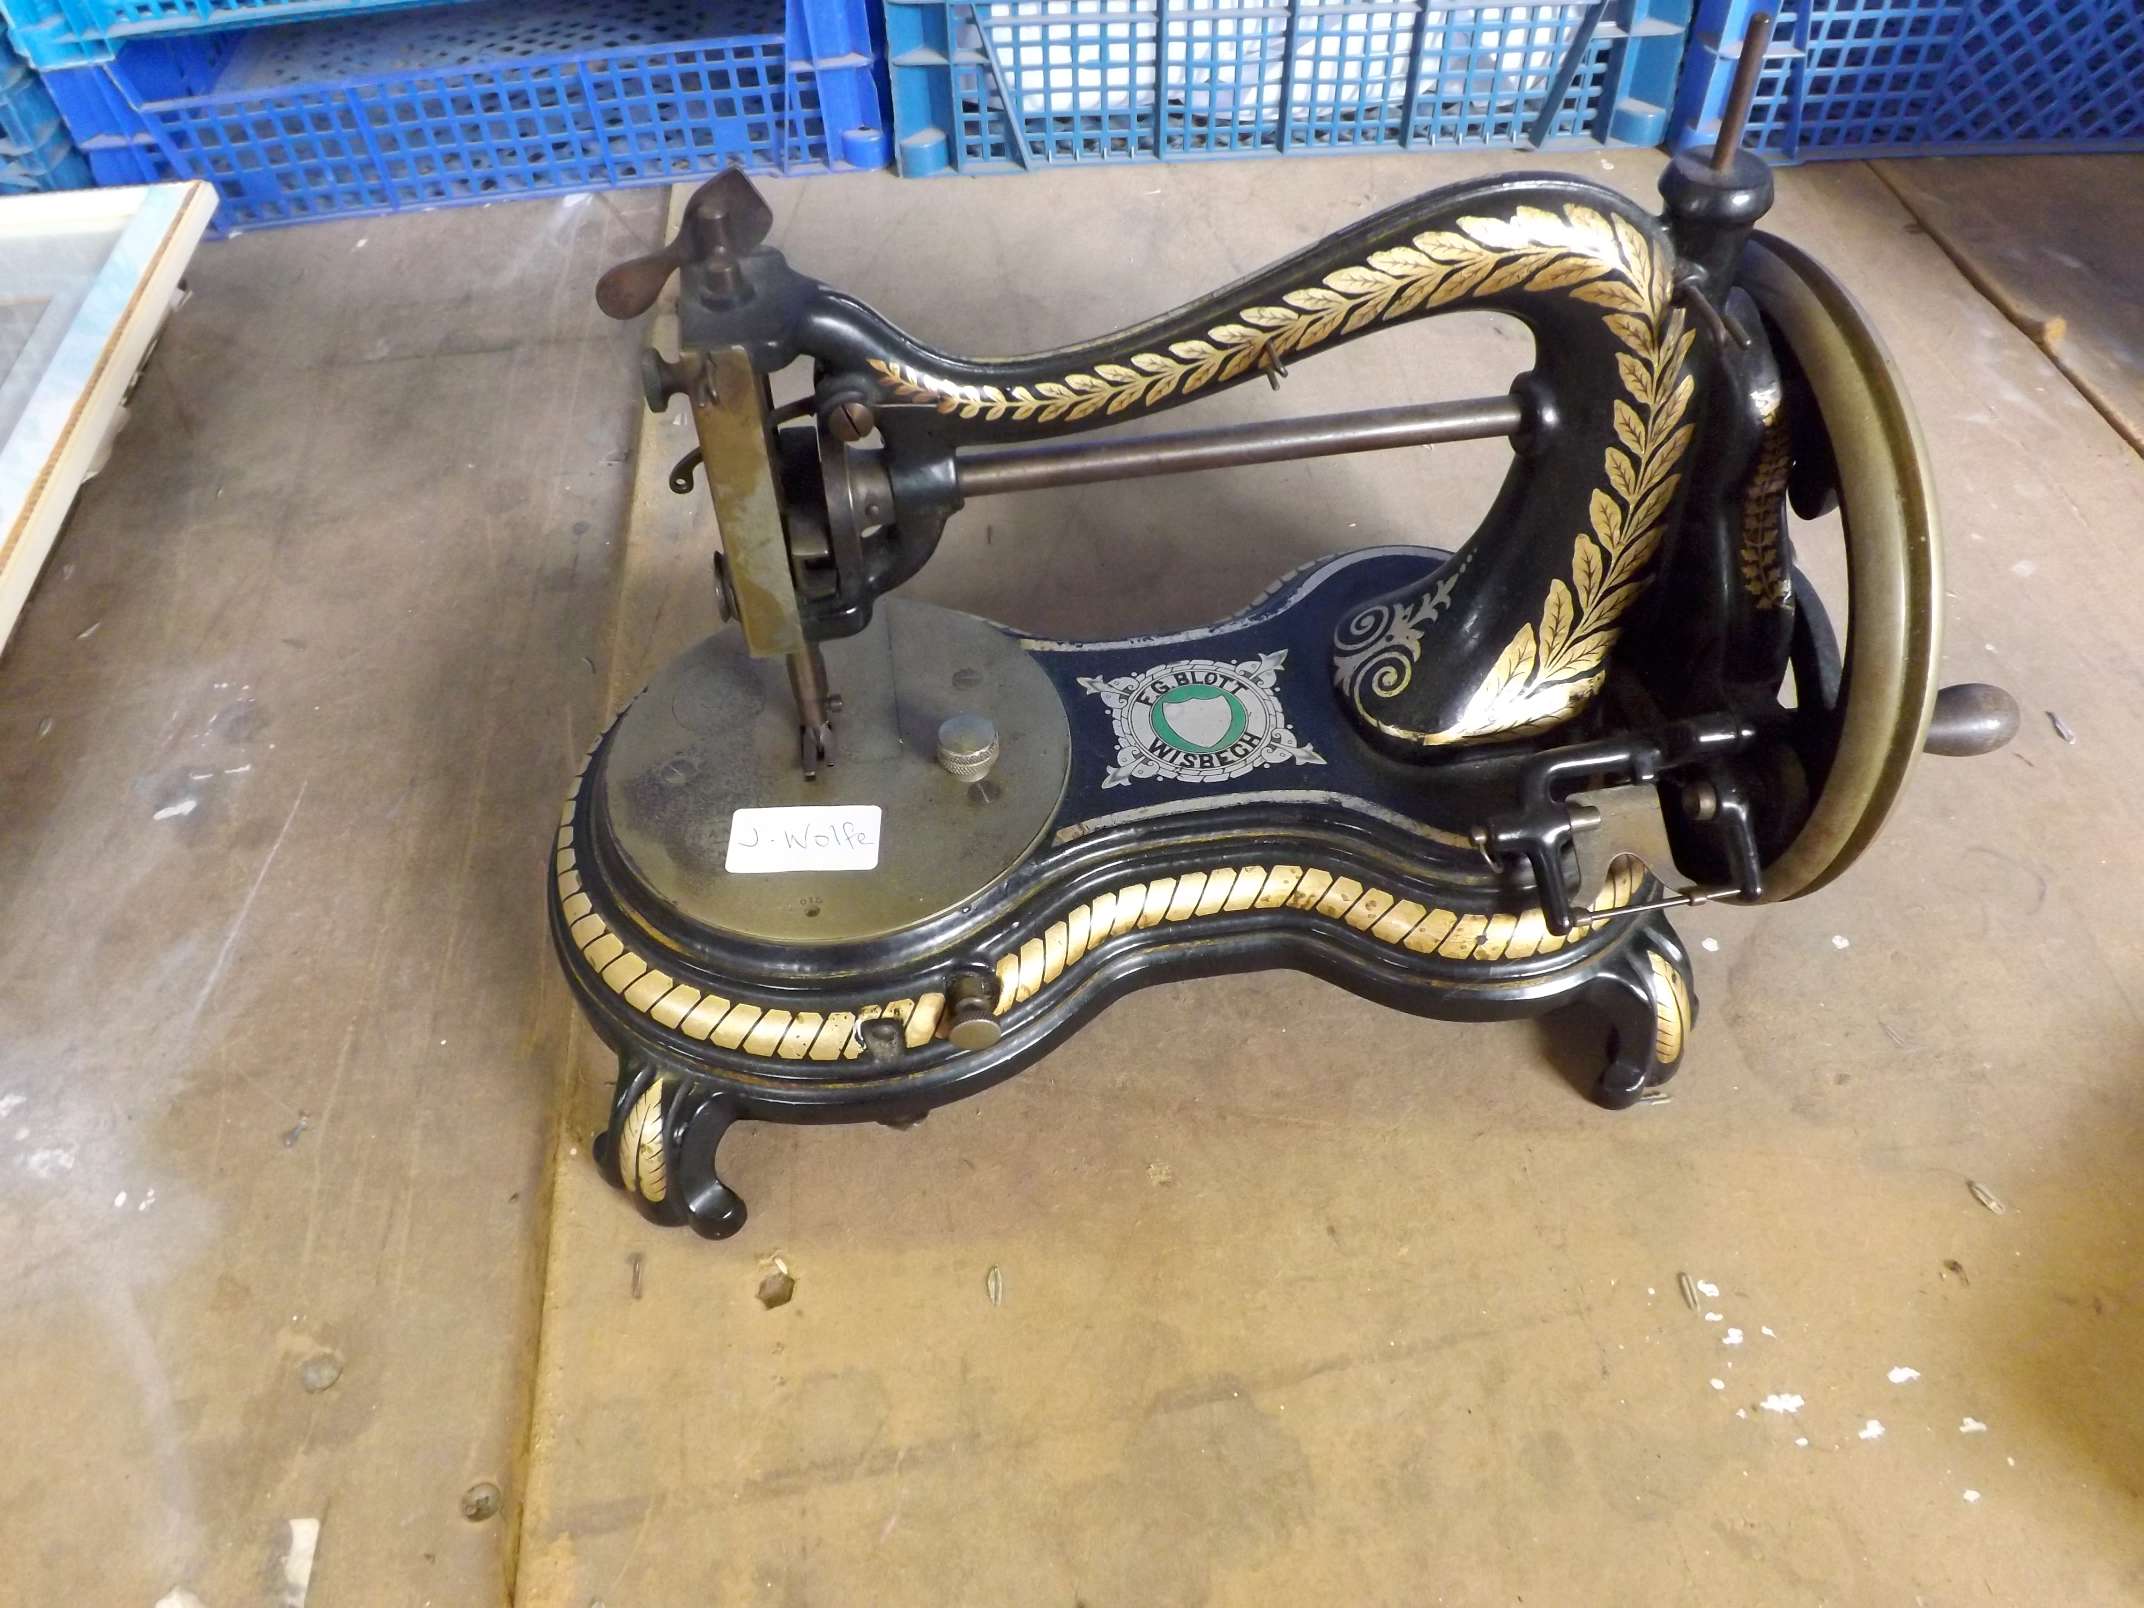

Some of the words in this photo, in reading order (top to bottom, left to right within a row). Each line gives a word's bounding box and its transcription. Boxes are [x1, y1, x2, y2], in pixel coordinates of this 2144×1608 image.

[1173, 671, 1249, 695] BLOTT
[1147, 732, 1262, 768] WISBECH
[784, 821, 875, 849] Wolfe
